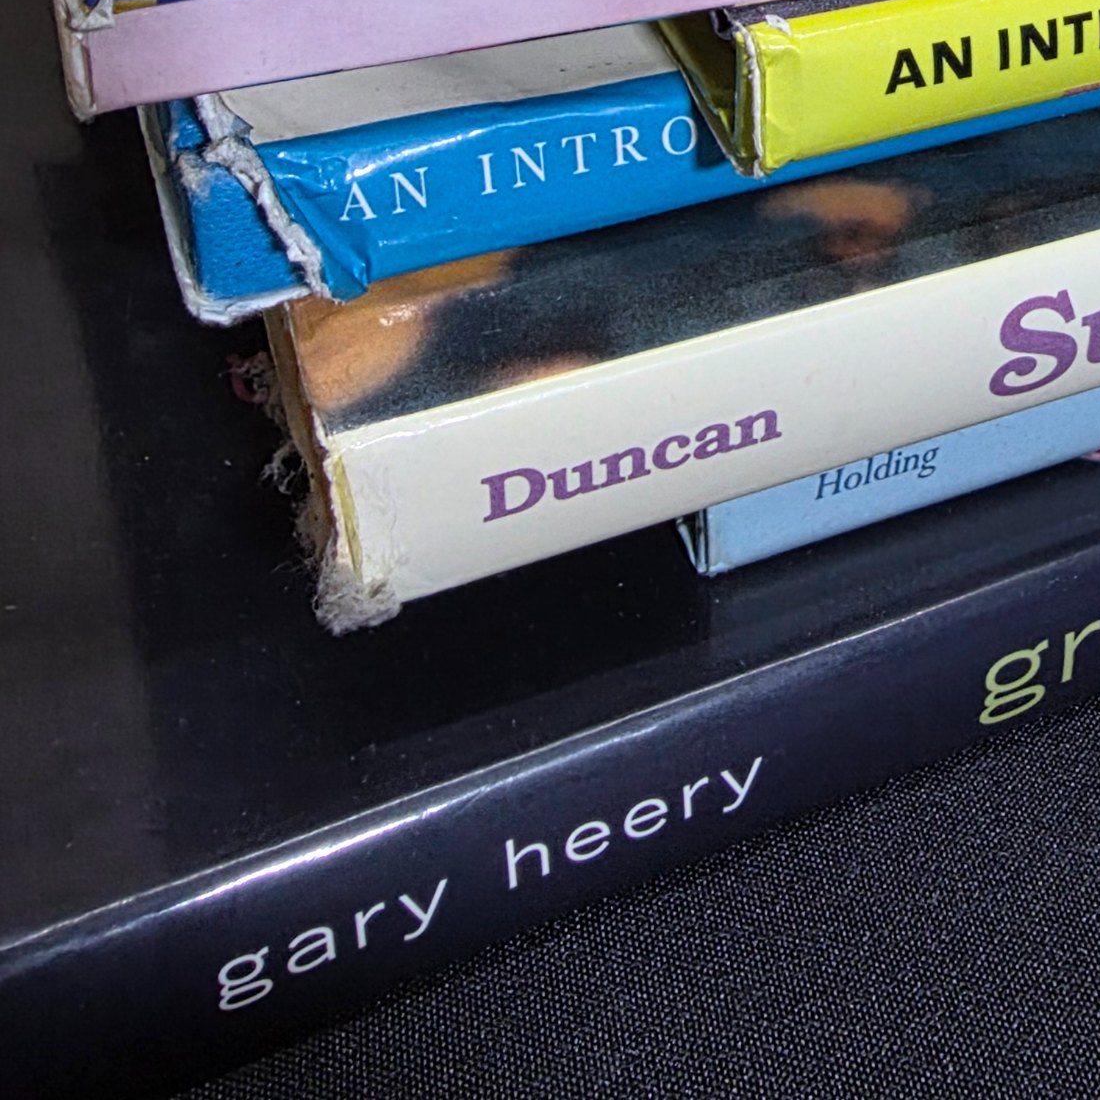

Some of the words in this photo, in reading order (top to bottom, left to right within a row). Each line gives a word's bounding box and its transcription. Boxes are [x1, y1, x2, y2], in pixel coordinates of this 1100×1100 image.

[885, 35, 973, 95] AN
[338, 166, 429, 223] AN
[478, 114, 699, 198] INTRO
[481, 407, 782, 524] Duncan
[814, 443, 940, 501] Holding
[216, 877, 449, 1012] gary
[505, 755, 764, 888] heery
